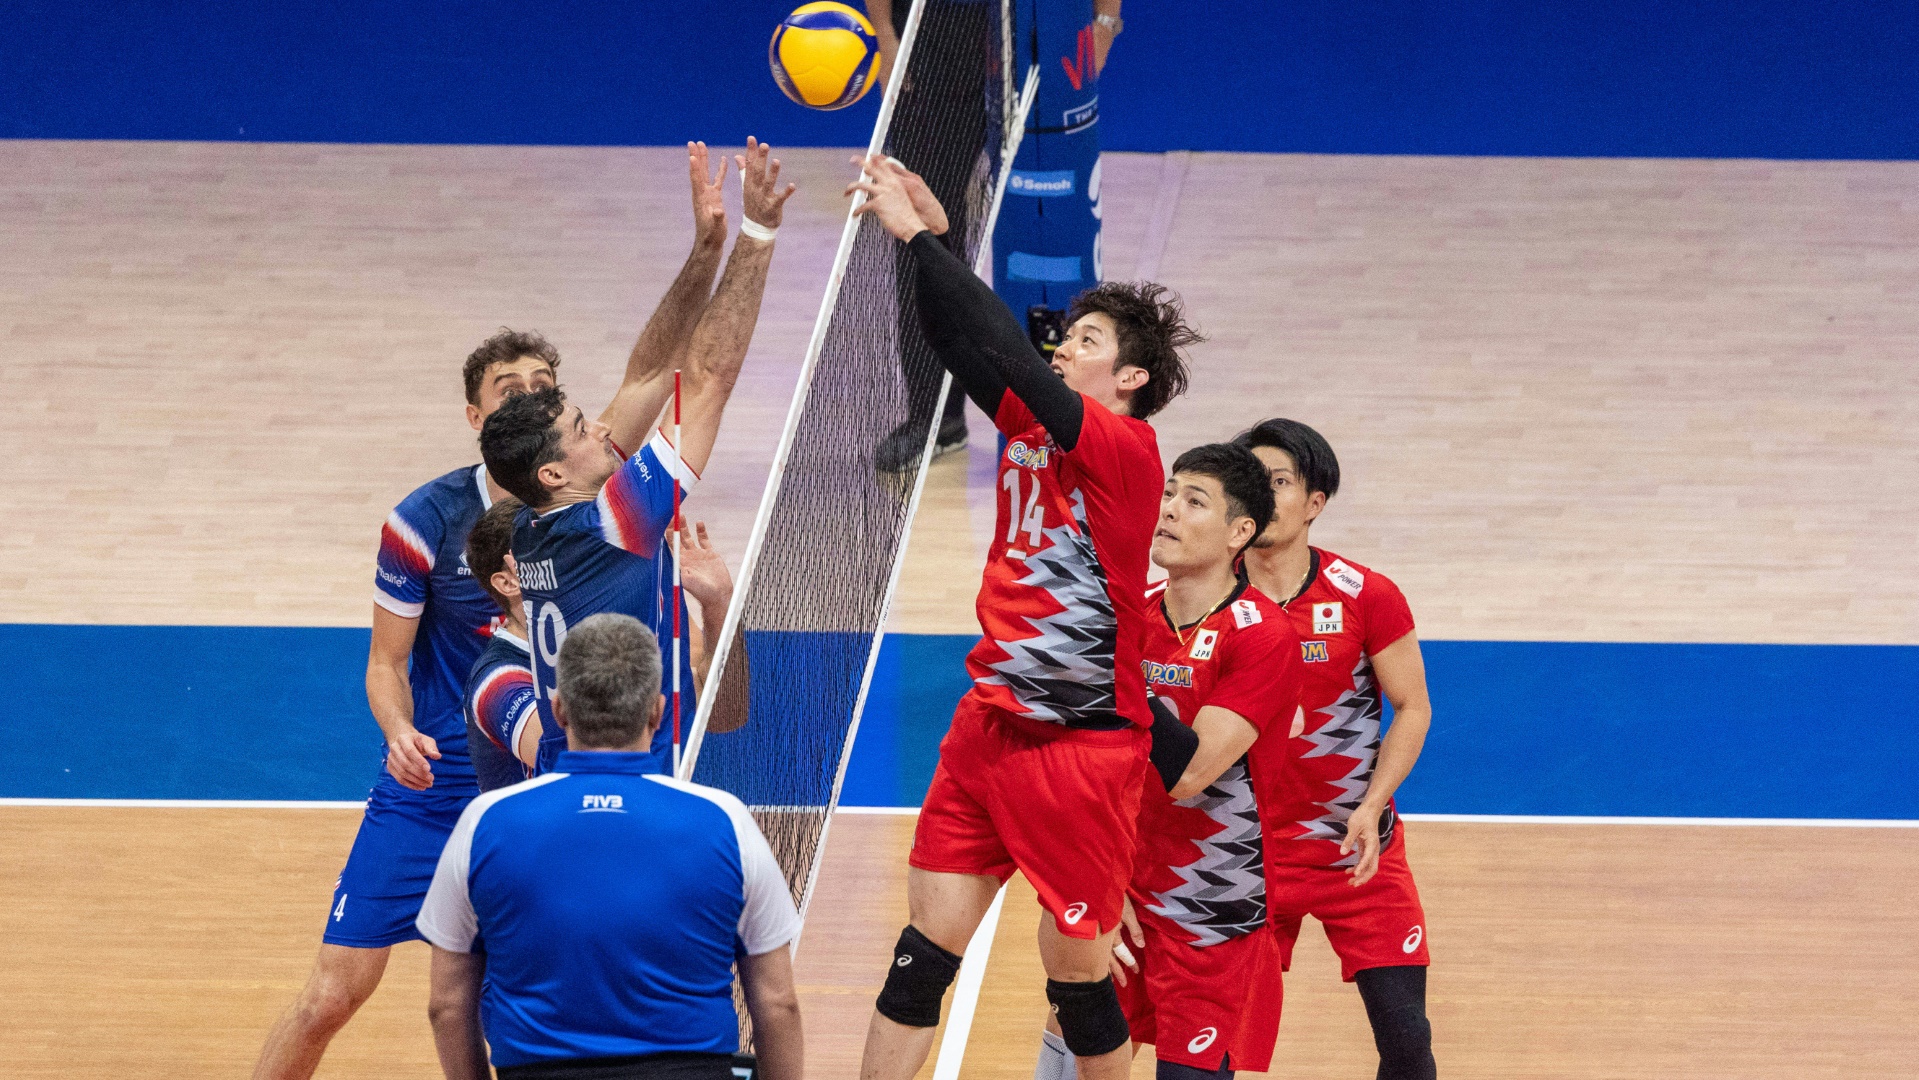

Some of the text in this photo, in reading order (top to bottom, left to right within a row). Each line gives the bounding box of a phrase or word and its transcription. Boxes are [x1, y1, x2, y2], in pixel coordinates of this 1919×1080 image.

[1023, 178, 1071, 191] Senoh
[1003, 468, 1045, 549] 14
[516, 558, 559, 591] OUATI
[1337, 573, 1361, 590] POWER
[1318, 623, 1338, 632] JPN
[1194, 649, 1211, 658] JPN
[582, 794, 623, 808] FIVB
[333, 893, 348, 922] 4
